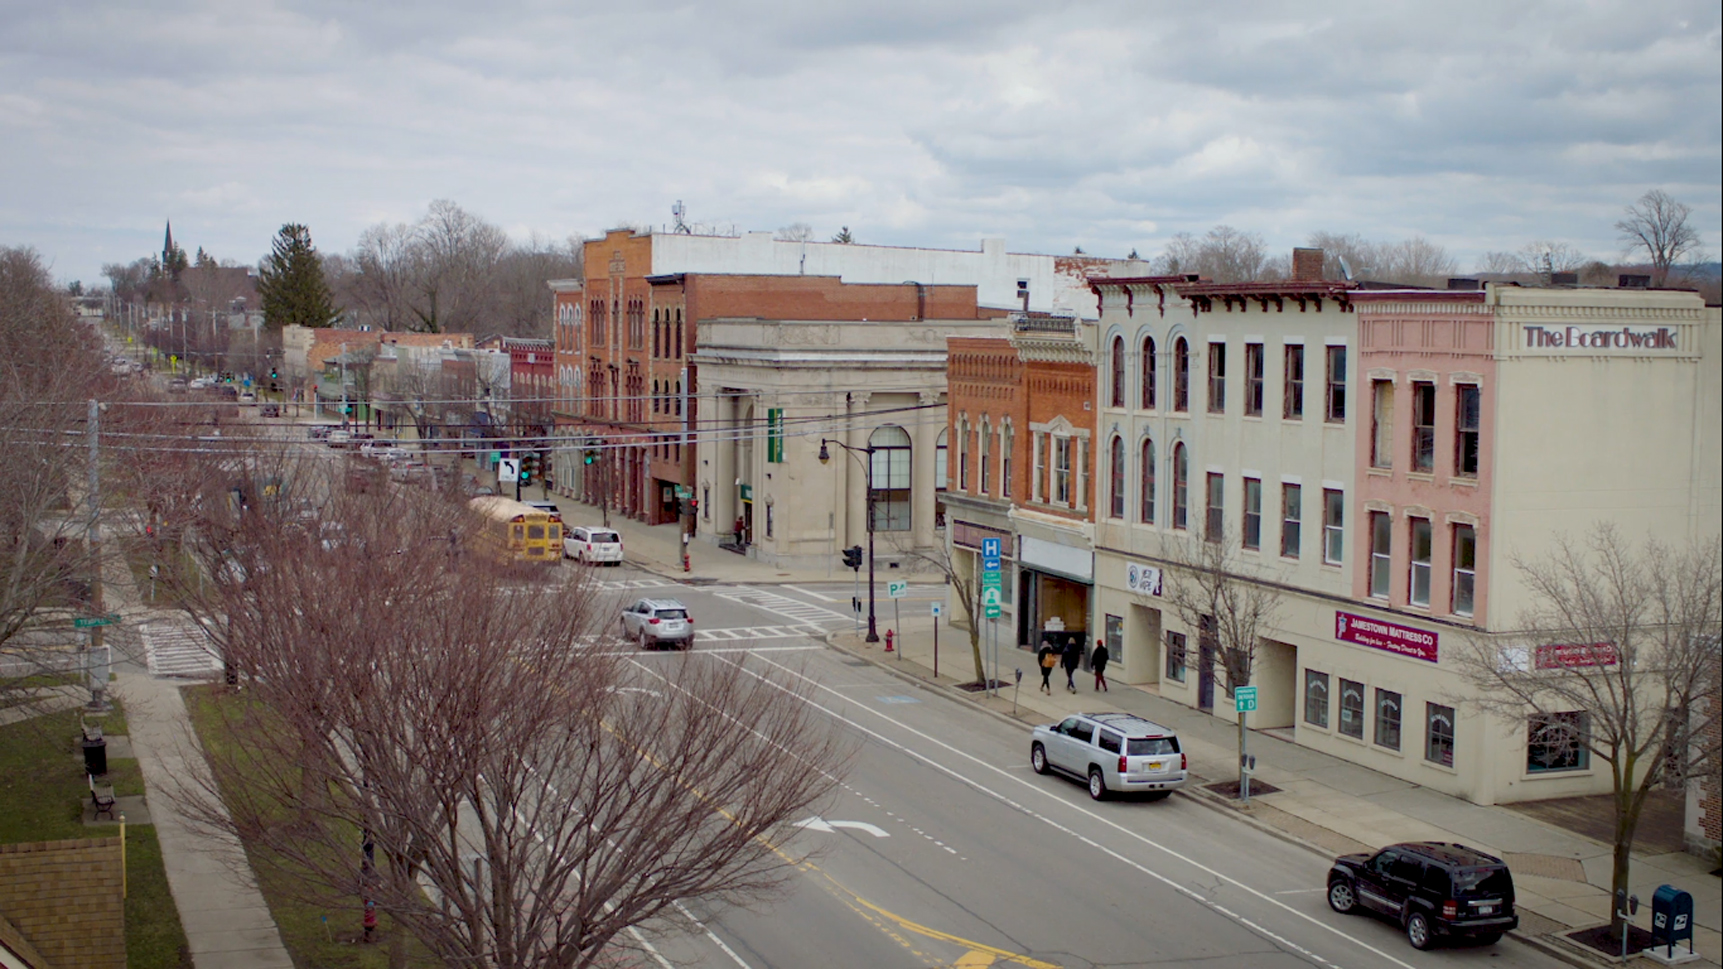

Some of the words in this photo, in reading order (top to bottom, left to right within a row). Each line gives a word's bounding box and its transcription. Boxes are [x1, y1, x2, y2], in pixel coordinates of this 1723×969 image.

[1523, 326, 1563, 348] The
[1566, 326, 1678, 348] Boardwalk
[985, 540, 997, 556] H
[890, 584, 898, 596] P
[1351, 618, 1388, 635] JAMESTOWN
[1389, 626, 1422, 643] MATTRESS
[1422, 634, 1433, 645] CO
[1247, 699, 1255, 710] D
